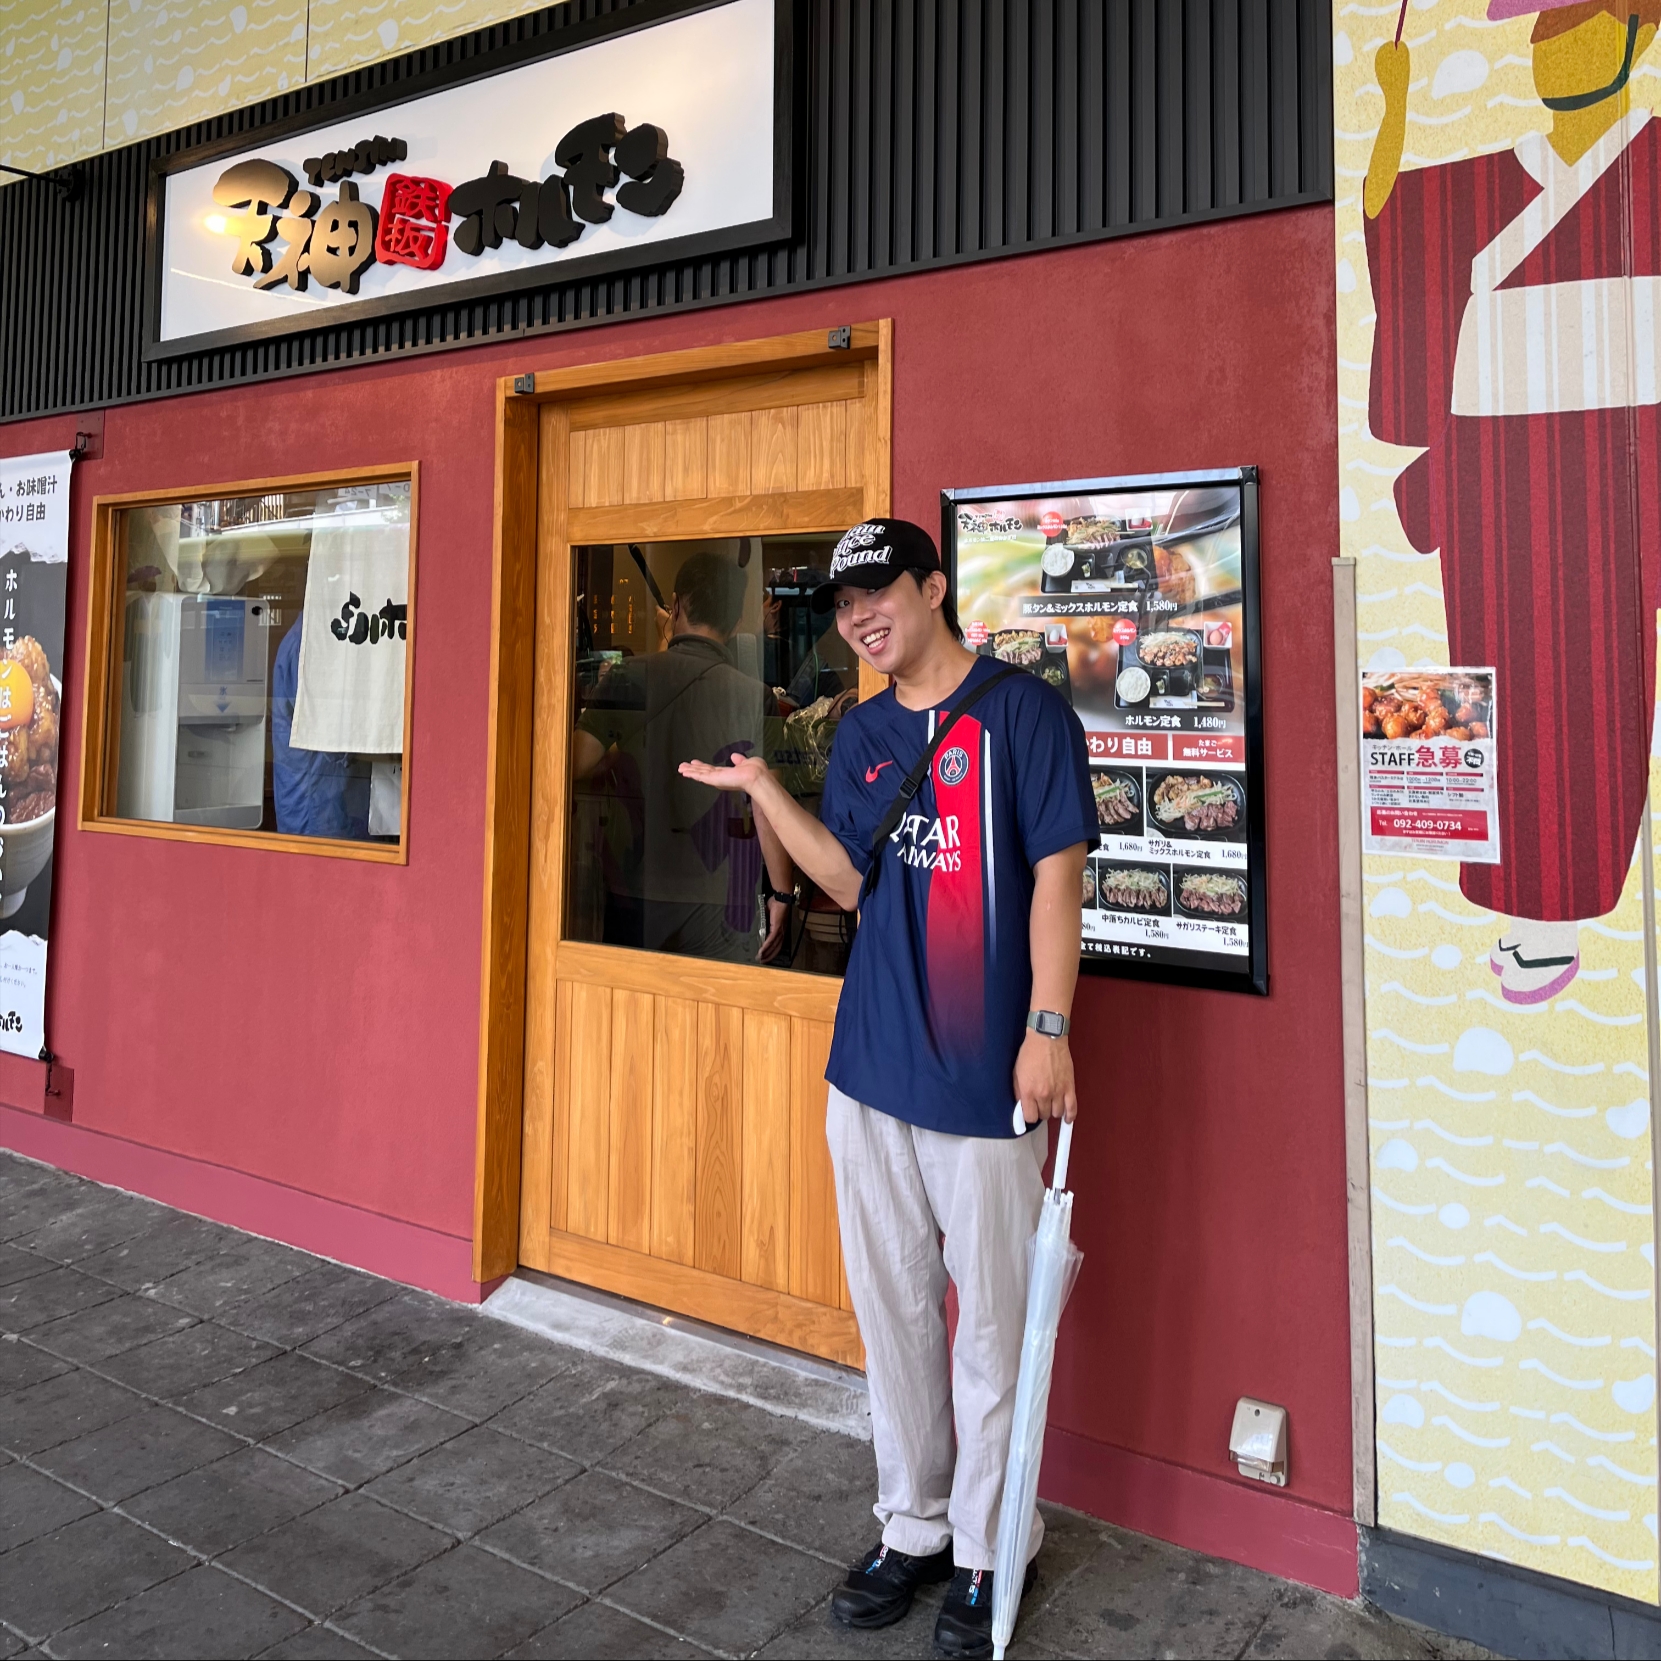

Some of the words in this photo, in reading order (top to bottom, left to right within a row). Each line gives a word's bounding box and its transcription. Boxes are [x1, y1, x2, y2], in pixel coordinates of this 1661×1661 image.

[303, 135, 407, 187] TENJIN
[450, 112, 685, 256] ホルモン
[1146, 600, 1178, 613] 1,580円
[1125, 714, 1182, 728] ホルモン定食
[1193, 716, 1227, 729] 1,480円
[1086, 735, 1152, 756] わり自由
[944, 749, 964, 760] PARIS
[1182, 746, 1234, 759] 無料サービス
[1370, 751, 1415, 766] STAFF
[1415, 745, 1462, 769] 急募
[1393, 818, 1462, 831] 092-409-0734
[1119, 841, 1143, 852] 1,680円
[1148, 839, 1173, 848] サガリ&
[1149, 847, 1211, 860] ミックスホルモン定食
[1101, 913, 1160, 929] 中落ちカルビ定食
[1145, 928, 1170, 940] 1,580円
[1175, 921, 1237, 936] サガリステーキ定食
